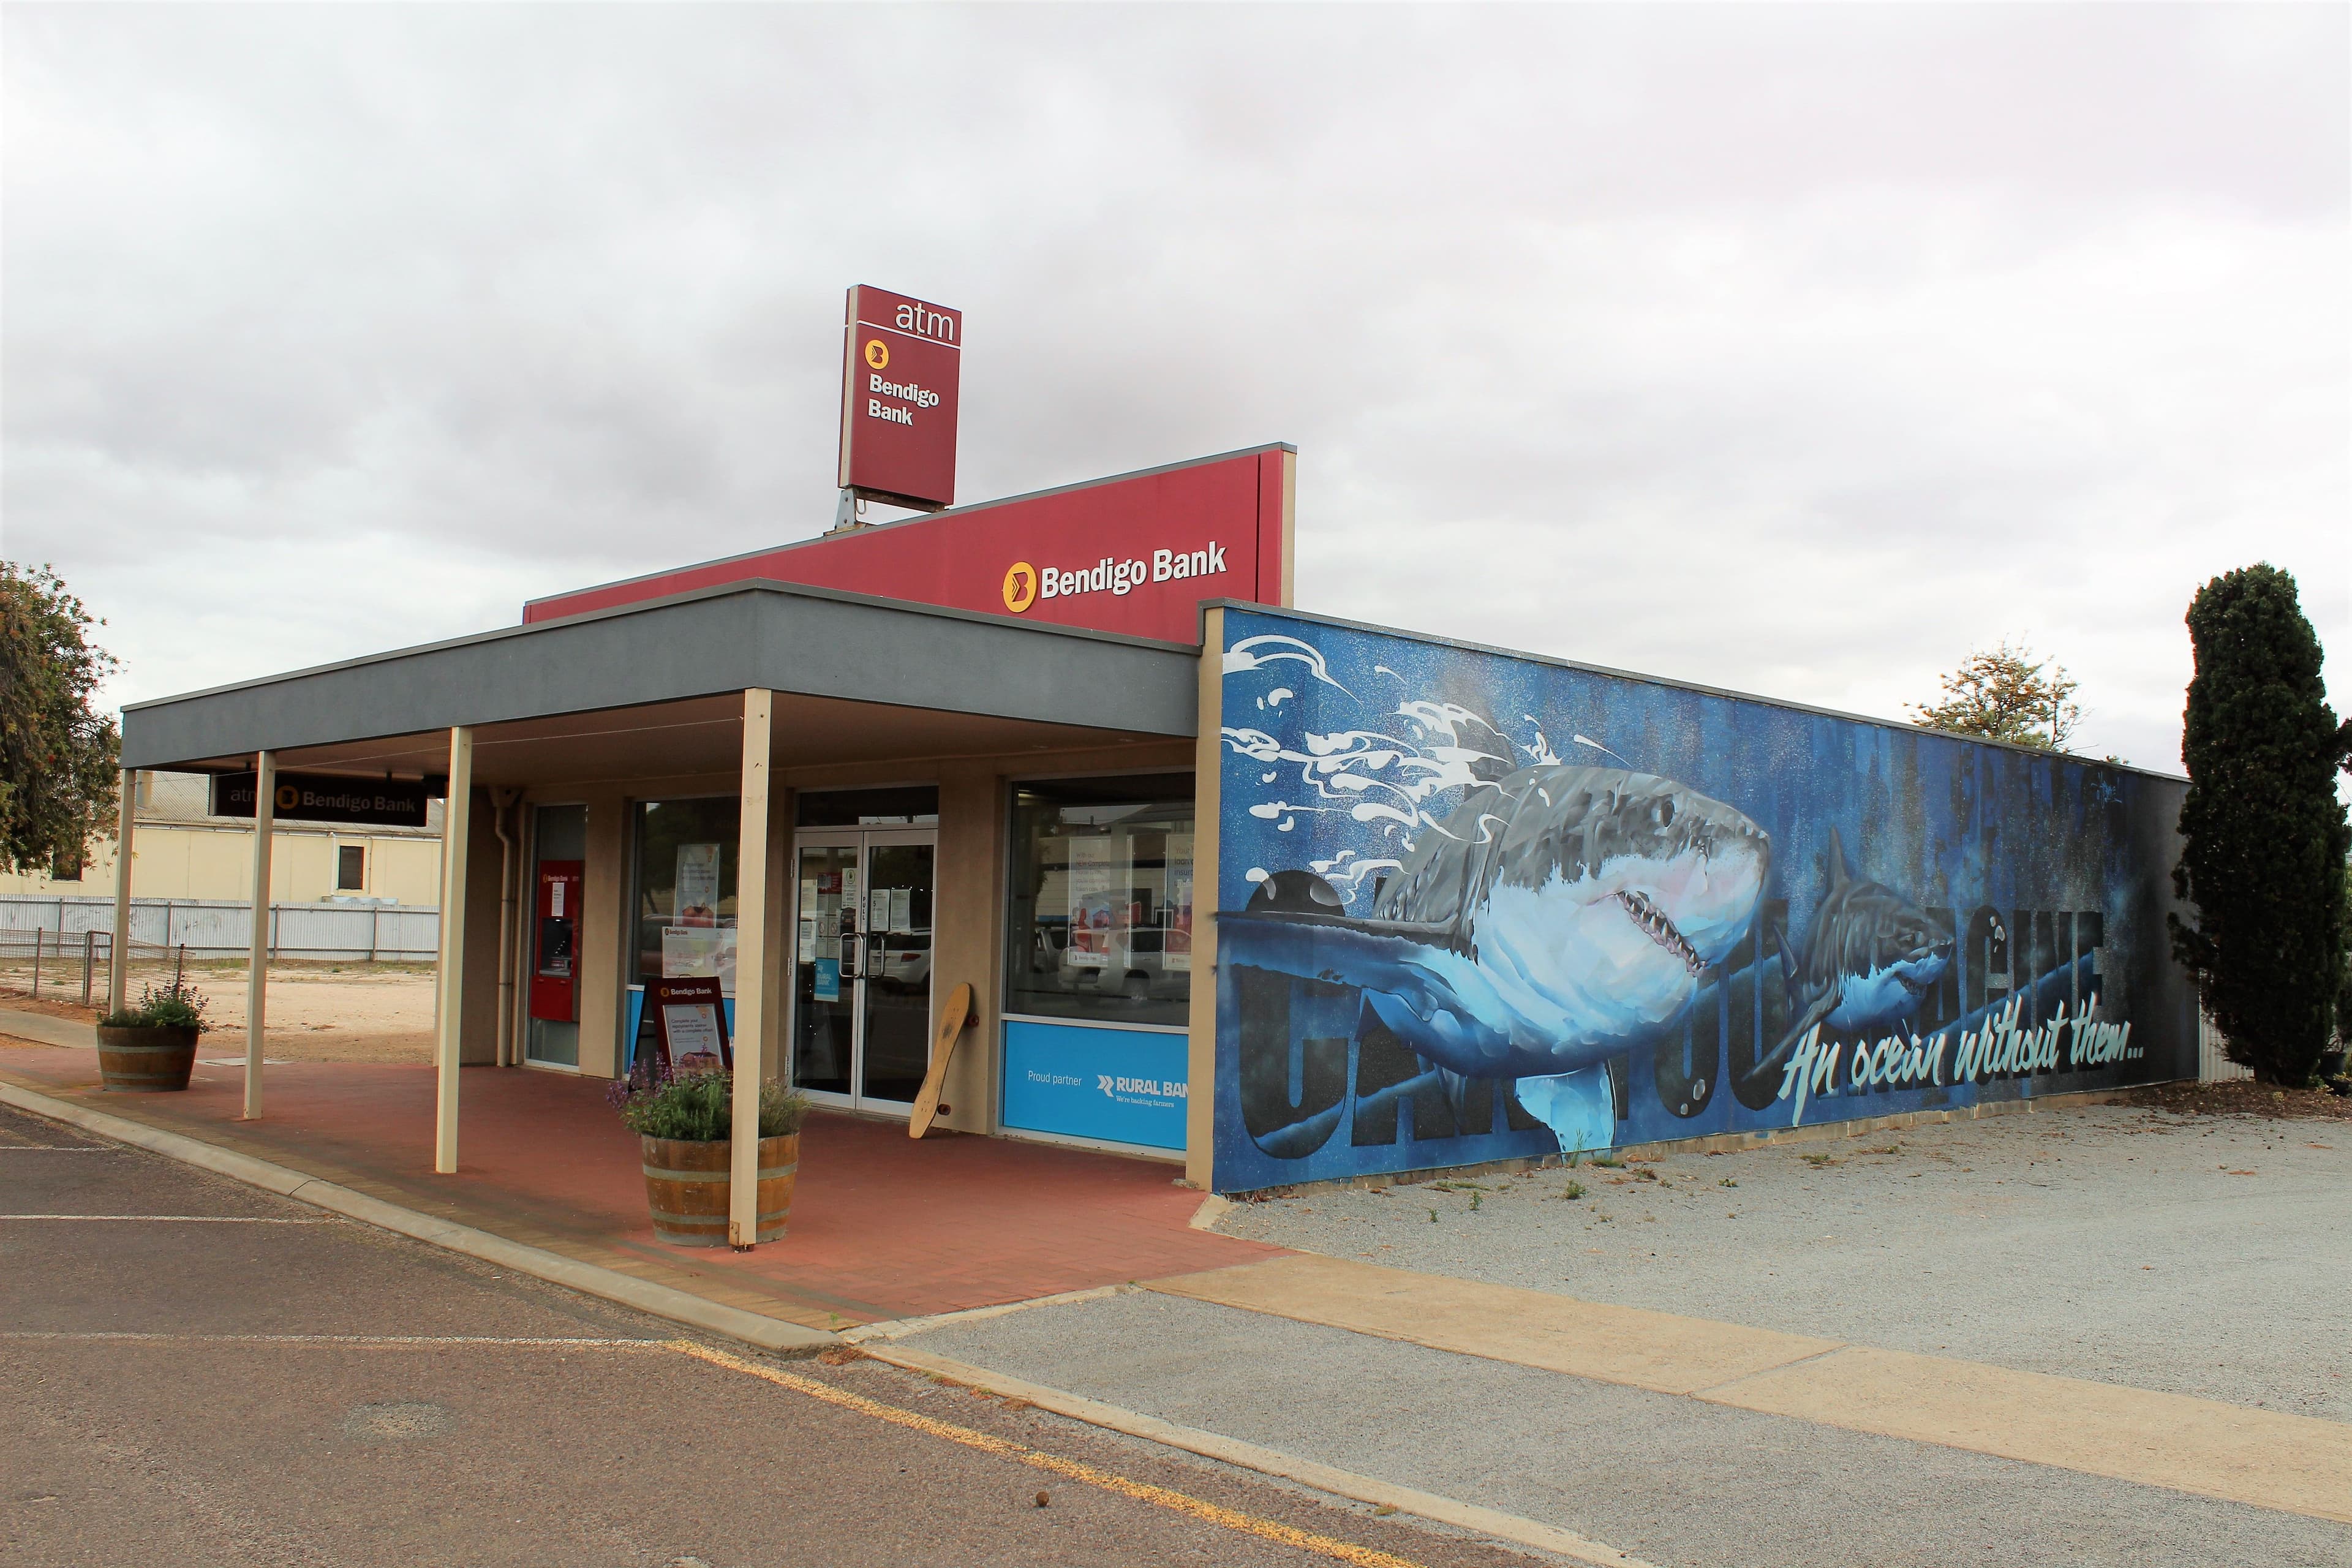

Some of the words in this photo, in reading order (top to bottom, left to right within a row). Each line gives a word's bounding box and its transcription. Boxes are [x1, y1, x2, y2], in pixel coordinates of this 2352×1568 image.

[895, 303, 954, 341] atm
[869, 373, 940, 409] Bendigo
[868, 398, 913, 426] Bank
[1041, 557, 1148, 599] Bendigo
[1153, 540, 1227, 582] Bank
[303, 791, 371, 812] Bendigo
[374, 796, 416, 813] Bank
[1777, 1021, 1841, 1128] An
[1850, 1033, 1947, 1087] ocean
[1954, 992, 2070, 1082] without
[1028, 1070, 1050, 1083] Proud
[1053, 1074, 1082, 1086] partner
[1116, 1077, 1161, 1096] RURAL
[1163, 1082, 1188, 1098] BAN
[1116, 1095, 1131, 1104] We're
[1131, 1096, 1152, 1107] backing
[1153, 1099, 1175, 1108] farmers
